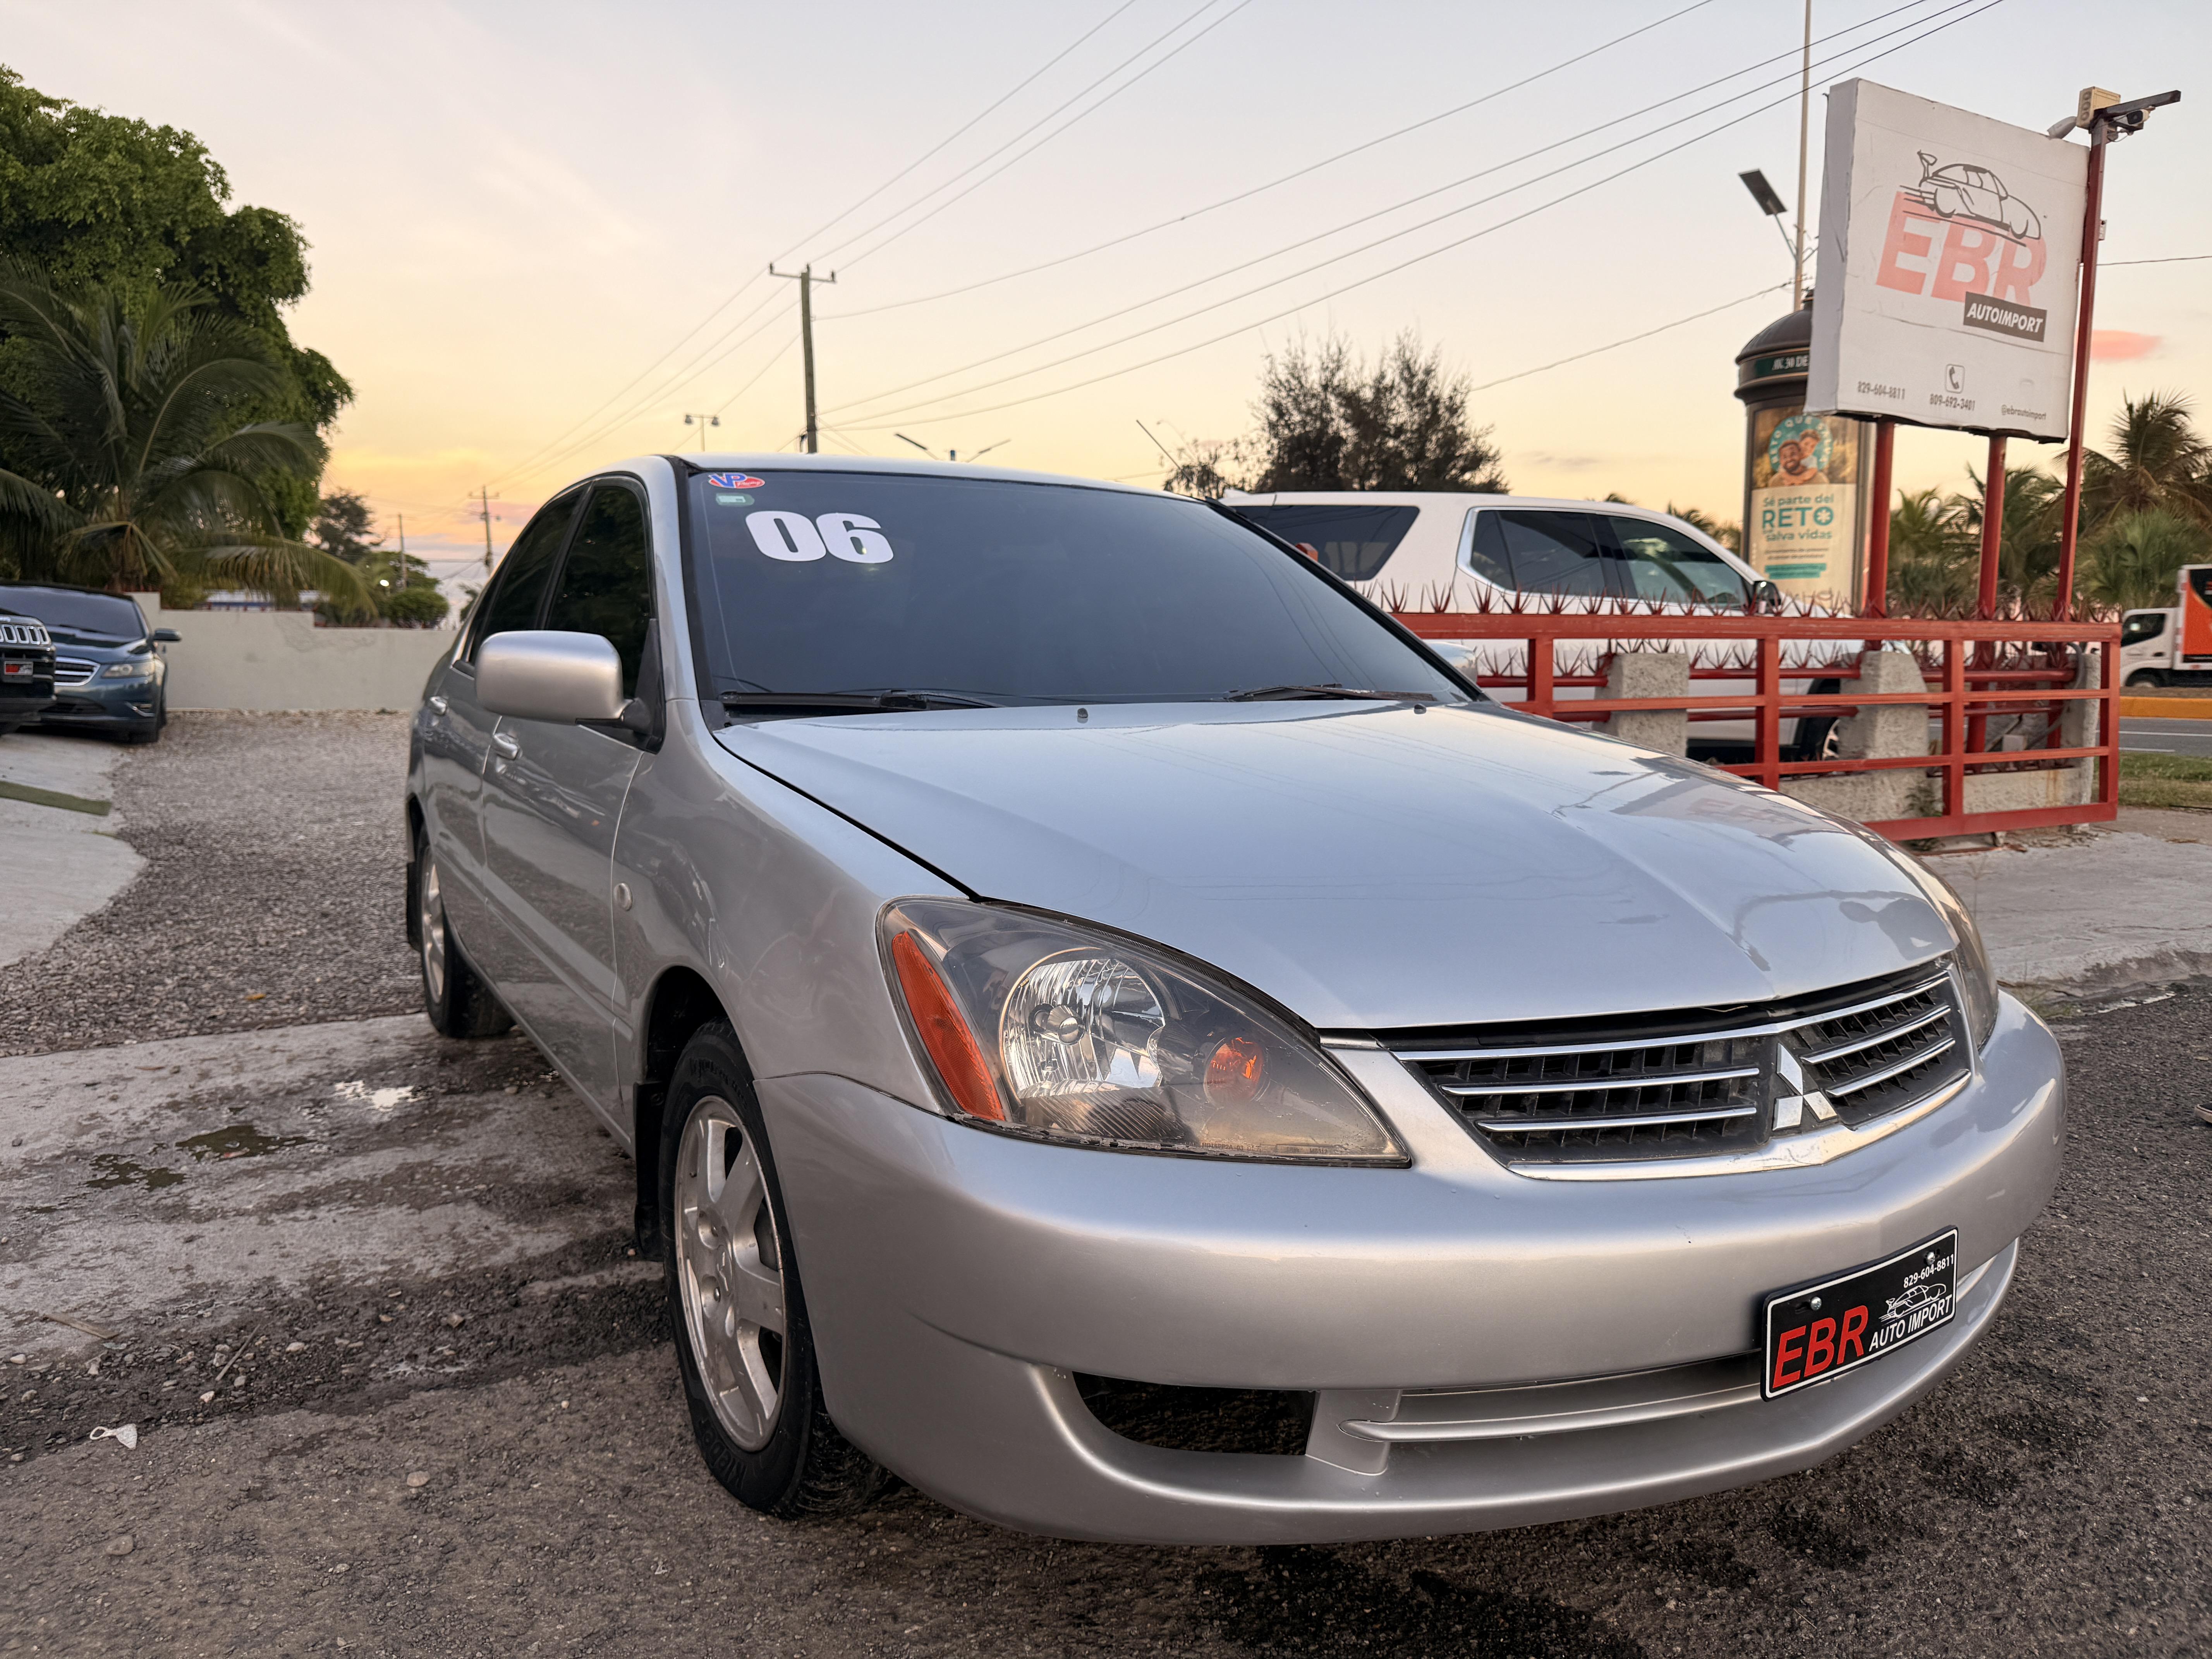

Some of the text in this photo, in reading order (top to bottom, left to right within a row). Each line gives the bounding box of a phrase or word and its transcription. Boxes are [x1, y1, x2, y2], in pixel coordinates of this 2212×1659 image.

[1876, 191, 2047, 307] EBR
[1966, 303, 2043, 333] AUTOIMPORT
[709, 473, 747, 488] VP
[1778, 495, 1811, 507] parte
[1815, 493, 1834, 503] del
[1762, 507, 1834, 528] RETO
[745, 511, 894, 564] 06
[1766, 529, 1832, 541] salva vidas
[1904, 1254, 1954, 1288] 829-604-8811
[1869, 1294, 1952, 1352] AUTO IMPORT
[1772, 1305, 1868, 1388] EBR
